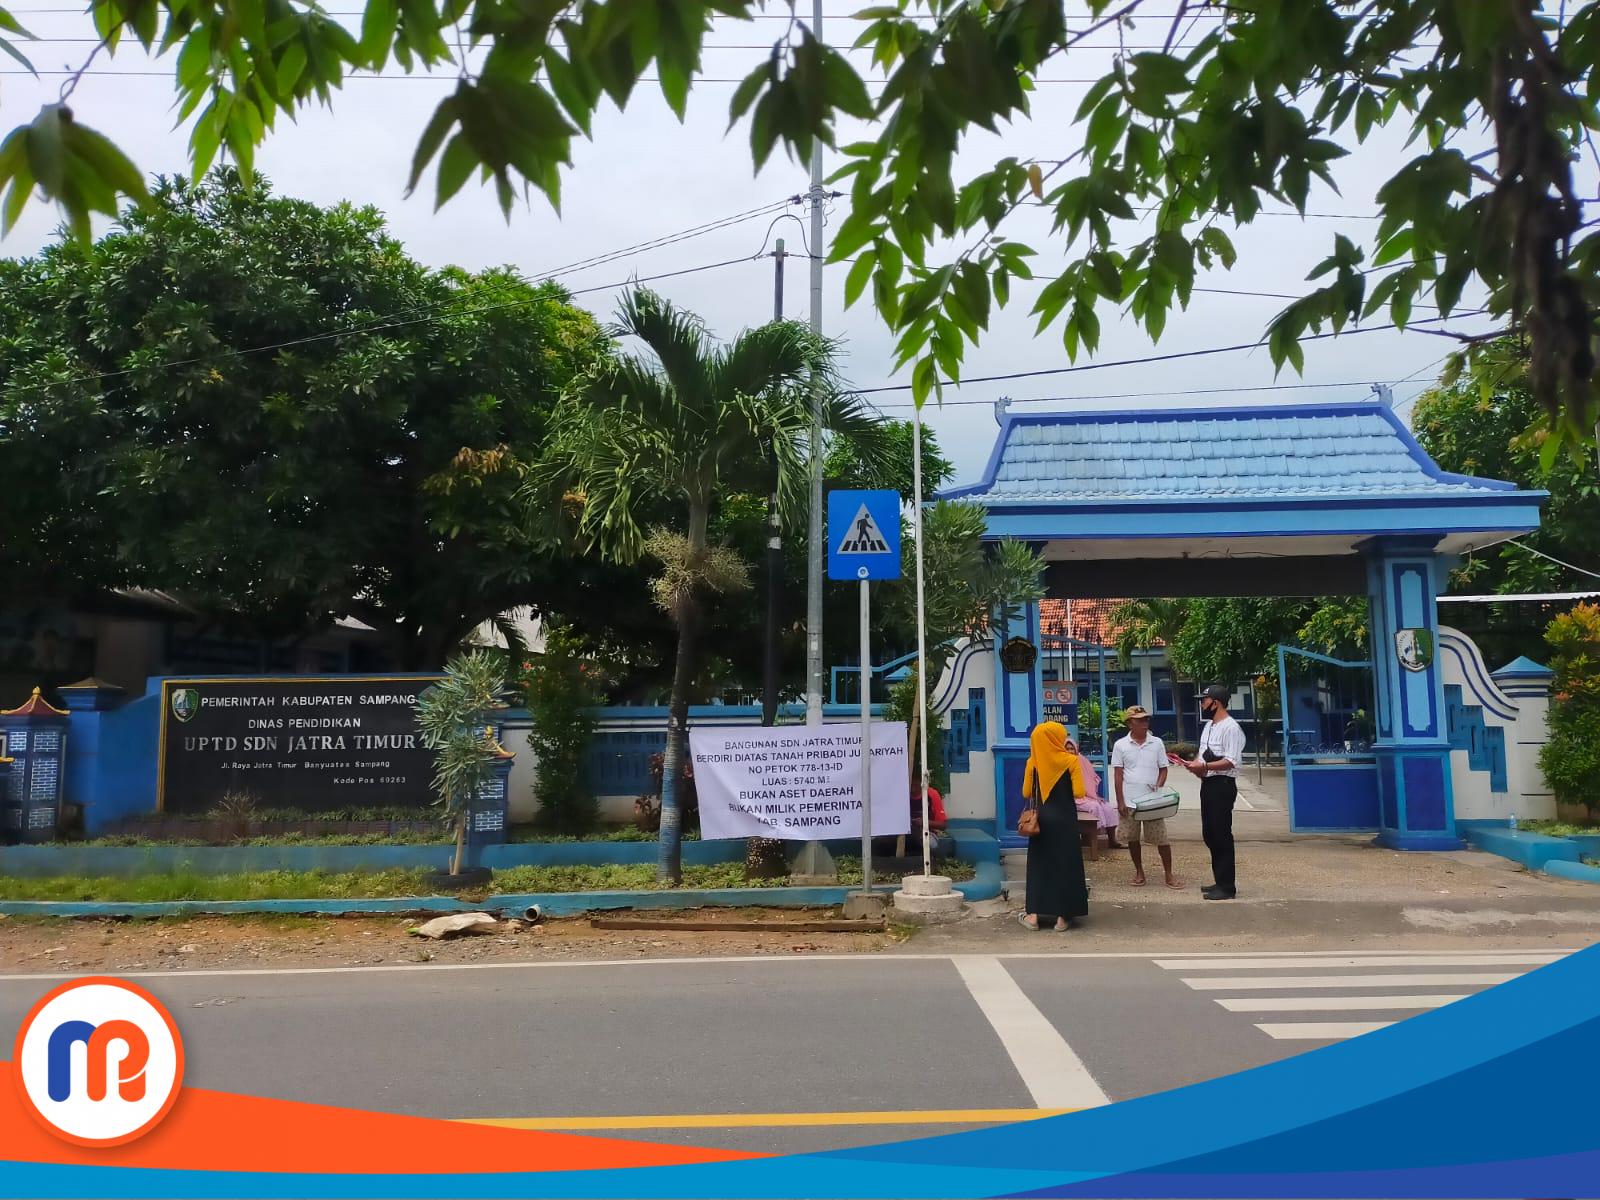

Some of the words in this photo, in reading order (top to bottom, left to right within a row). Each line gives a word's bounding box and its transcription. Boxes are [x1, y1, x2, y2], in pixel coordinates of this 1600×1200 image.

[201, 696, 275, 707] PEMERINTAH
[282, 695, 352, 706] KABUPATEN
[359, 694, 416, 705] SAMPANG
[248, 719, 284, 729] DINAS
[288, 718, 361, 728] PENDIDIKAN
[184, 736, 237, 751] UPTD
[243, 736, 278, 751] SDN
[287, 735, 346, 753] JATRA
[353, 734, 416, 750] TIMUR
[724, 740, 778, 750] BANGUNAN
[780, 739, 799, 748] SDN
[802, 738, 834, 747] JATRA
[696, 754, 732, 763] BERDIRI
[735, 753, 768, 762] DIATAS
[770, 752, 803, 761] TANAH
[806, 749, 846, 759] PRIBADI
[849, 747, 903, 757] JUARIYAH
[232, 762, 251, 770] Raya
[355, 760, 390, 769] Sampang
[748, 765, 762, 774] NO
[765, 764, 798, 773] PETOK
[800, 762, 843, 772] 778-13-ID
[794, 777, 815, 785] 5740
[739, 790, 776, 800] BUKAN
[779, 789, 806, 799] ASET
[809, 786, 854, 798] DAERAH
[729, 803, 762, 814] BUKAN
[765, 803, 796, 814] MILIK
[784, 815, 841, 827] SAMPANG
